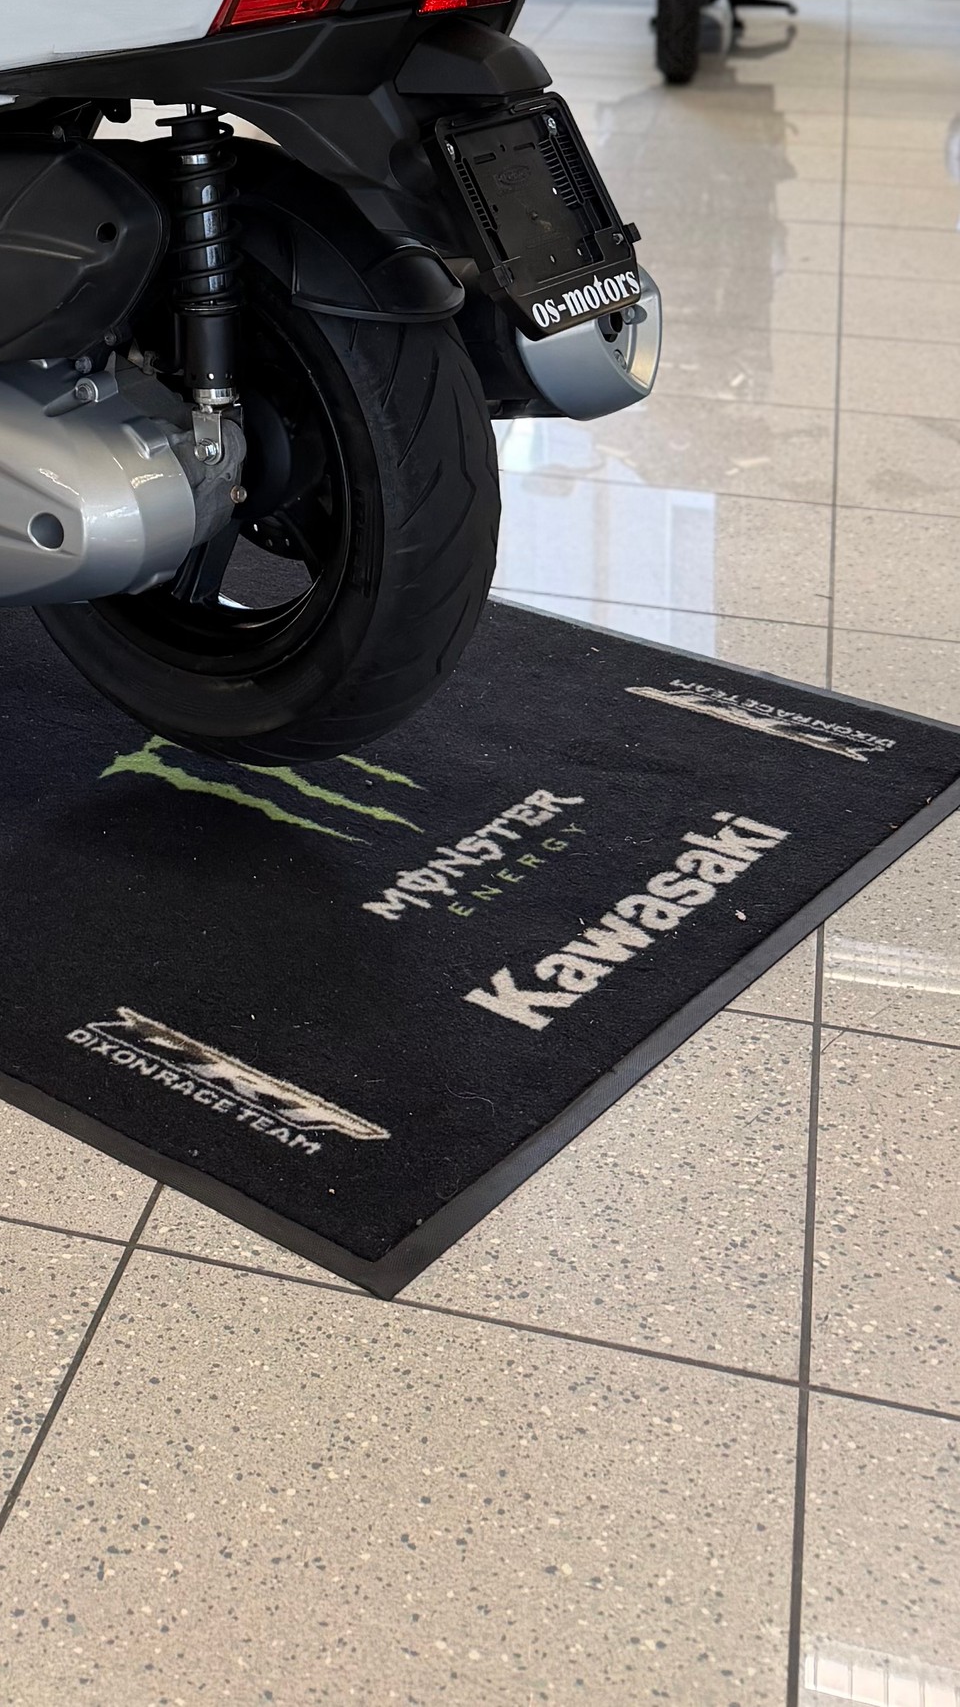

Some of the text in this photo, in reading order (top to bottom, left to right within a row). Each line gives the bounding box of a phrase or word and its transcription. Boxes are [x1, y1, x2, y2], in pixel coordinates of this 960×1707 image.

[531, 270, 641, 329] os-motors
[668, 678, 742, 705] TEAM
[361, 788, 585, 921] MONSTER
[447, 821, 587, 918] ENERGY
[461, 810, 792, 1032] Kawasaki
[236, 1106, 322, 1156] TEAM
